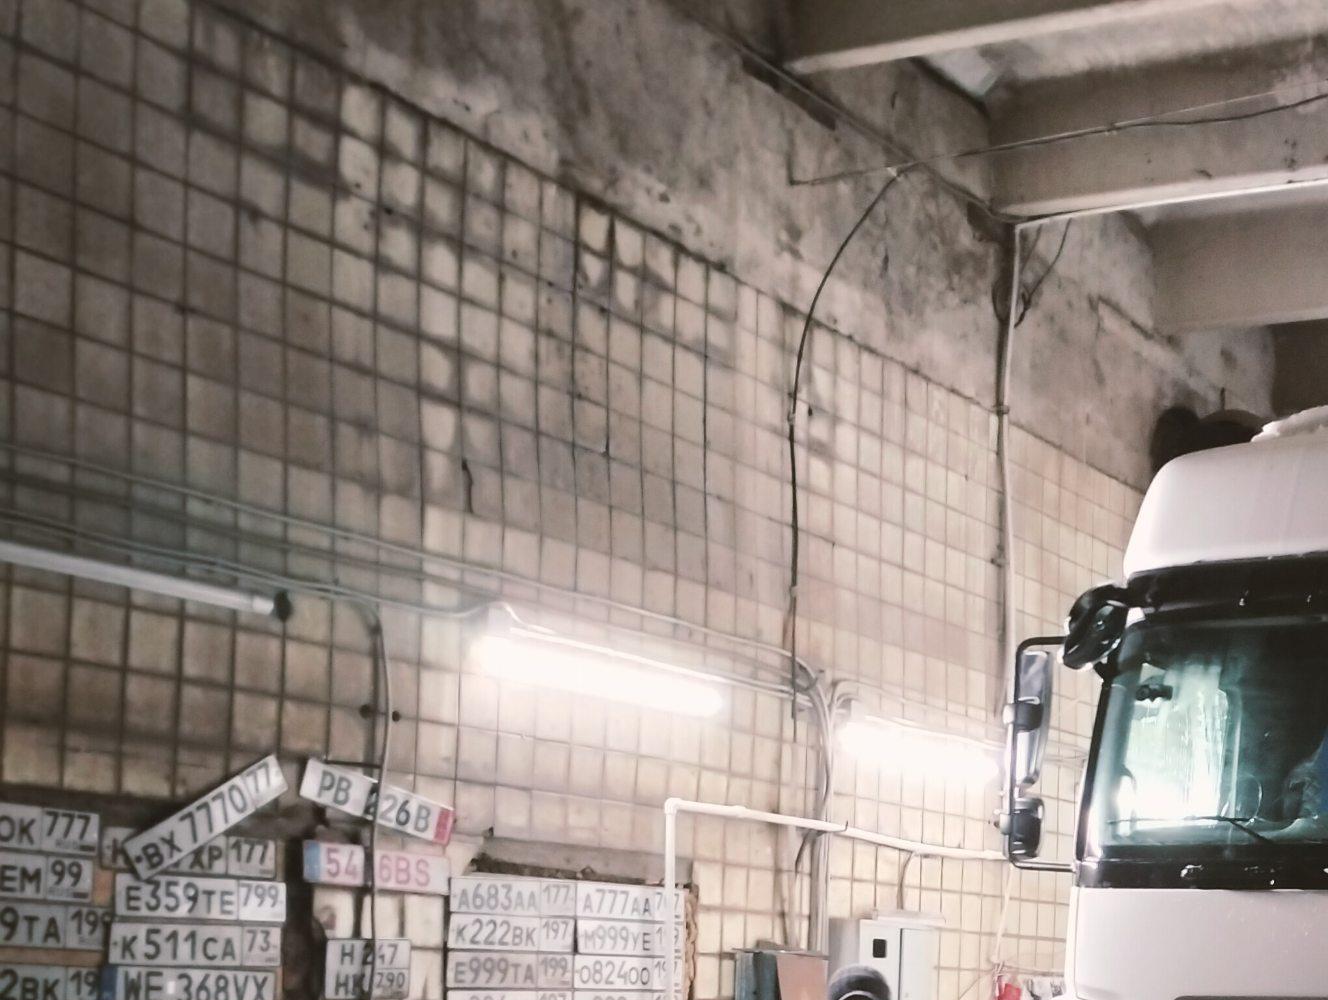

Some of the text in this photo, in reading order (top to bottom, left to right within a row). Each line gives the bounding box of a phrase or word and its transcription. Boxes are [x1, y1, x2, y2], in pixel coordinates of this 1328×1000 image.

[46, 811, 91, 841] 777
[51, 859, 83, 888] 99
[126, 880, 279, 915] E359TE 799
[121, 928, 271, 960] K511CA 73
